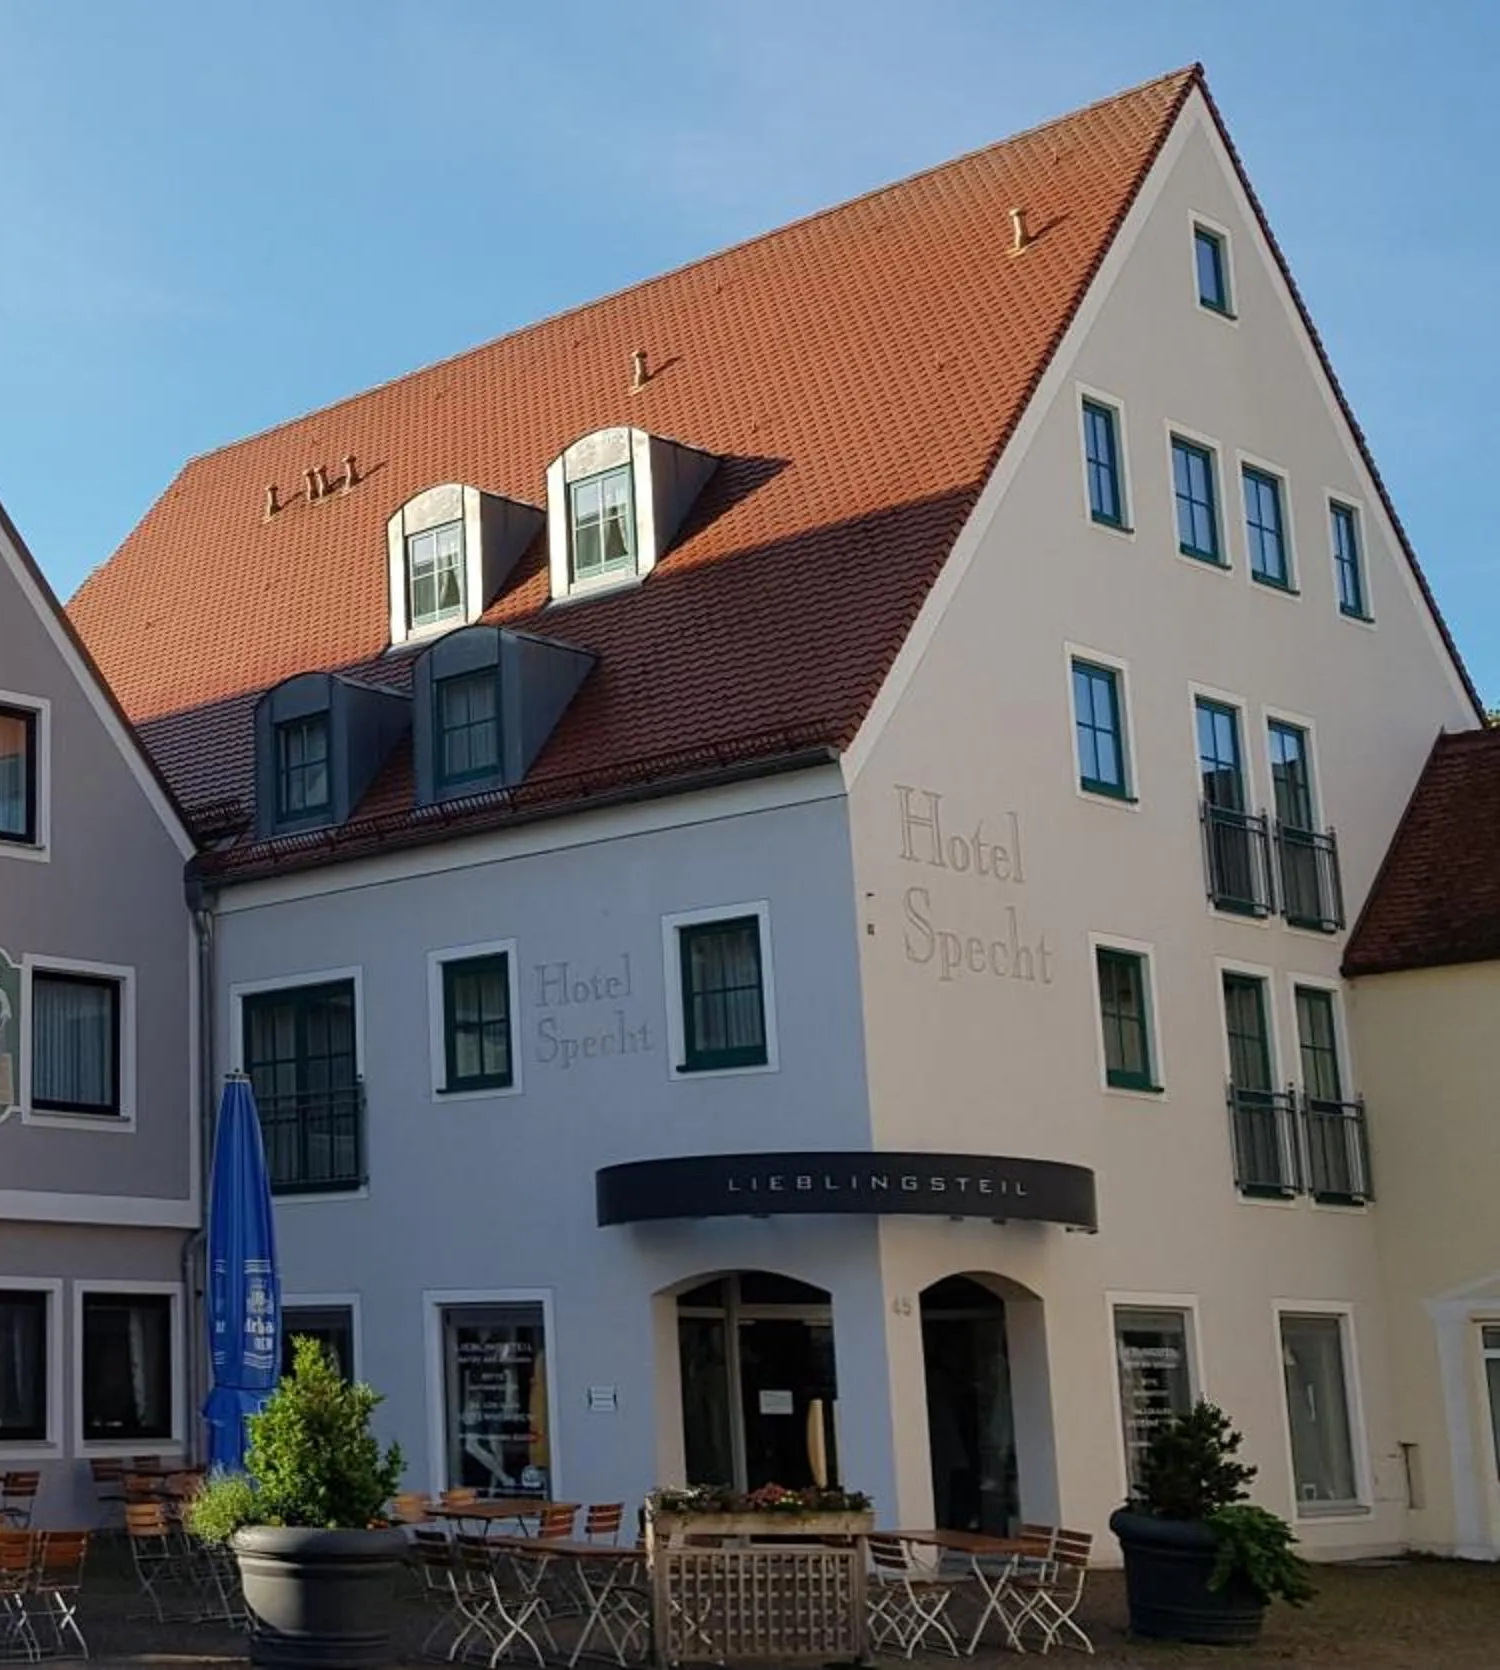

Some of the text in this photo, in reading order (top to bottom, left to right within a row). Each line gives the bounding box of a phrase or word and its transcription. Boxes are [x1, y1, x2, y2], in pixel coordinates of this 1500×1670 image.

[893, 783, 1025, 884] Hotel
[903, 886, 1053, 985] Specht
[533, 951, 631, 1008] Hotel
[535, 1009, 655, 1070] Specht
[728, 1174, 1029, 1196] LIEBLINGSTEIL
